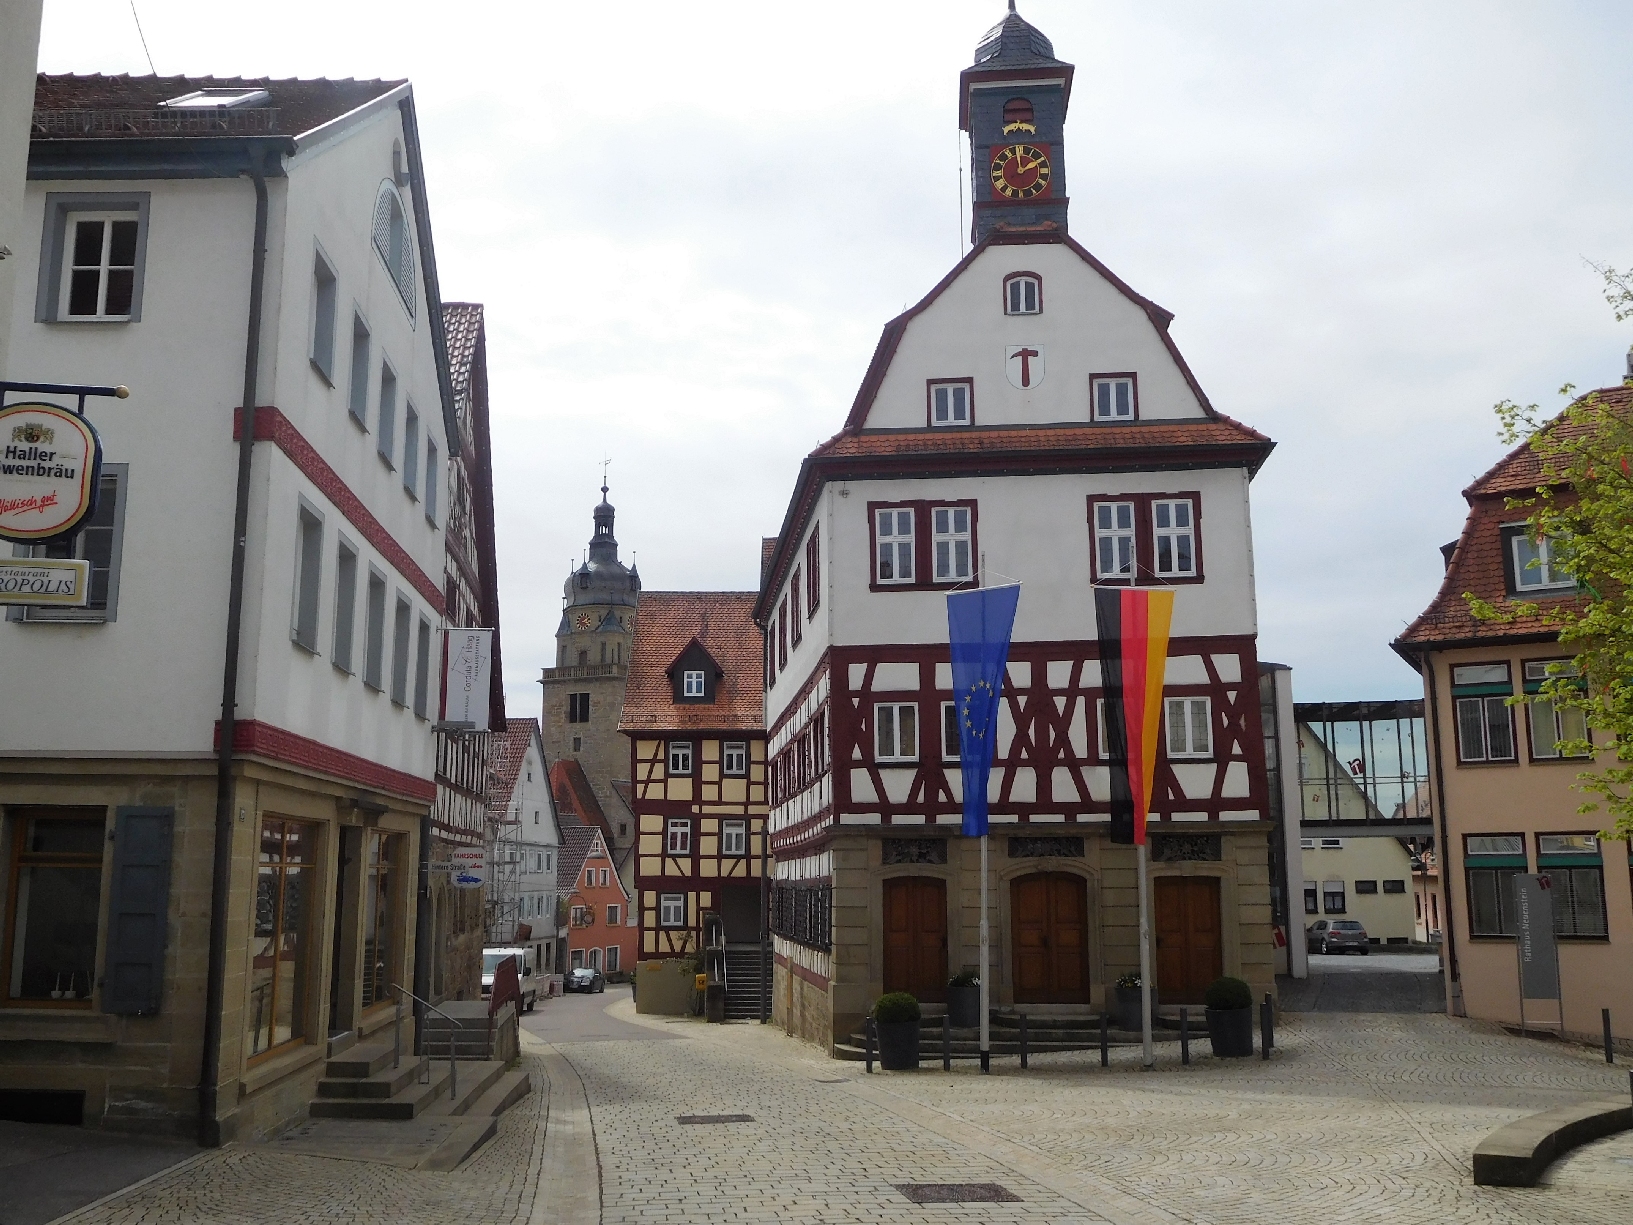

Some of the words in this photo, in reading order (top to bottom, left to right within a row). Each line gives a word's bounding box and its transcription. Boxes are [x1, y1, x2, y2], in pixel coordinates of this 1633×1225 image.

[5, 445, 56, 461] Haller
[0, 462, 75, 479] wenbräu
[1520, 887, 1530, 930] Neuenstein
[1523, 931, 1532, 962] Rathaus
